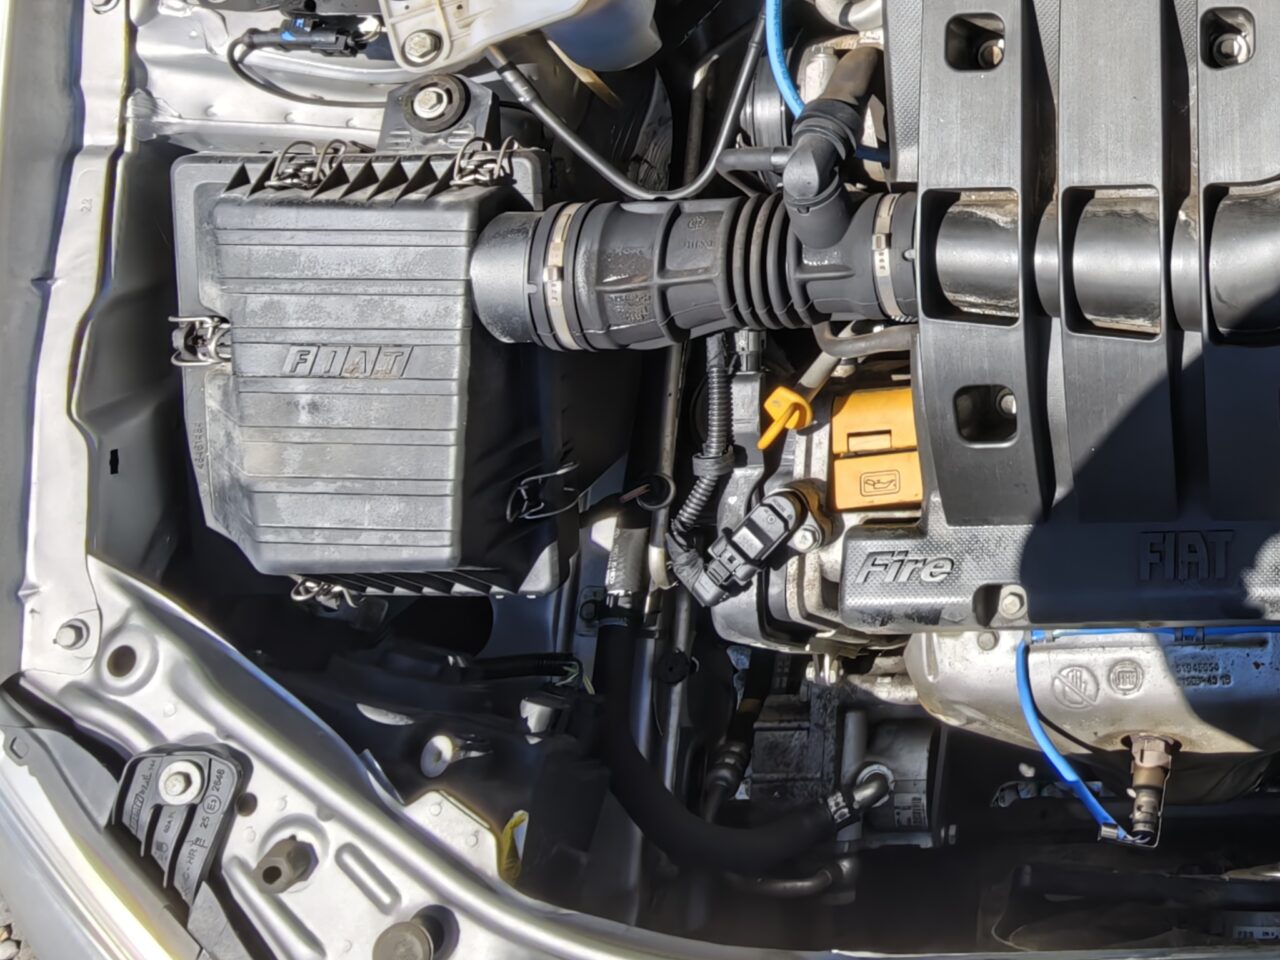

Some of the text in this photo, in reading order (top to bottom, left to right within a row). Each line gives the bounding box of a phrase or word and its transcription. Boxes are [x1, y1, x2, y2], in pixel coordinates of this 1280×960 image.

[287, 348, 406, 375] FIAT
[855, 551, 955, 584] Fire
[1139, 529, 1235, 581] FIAT
